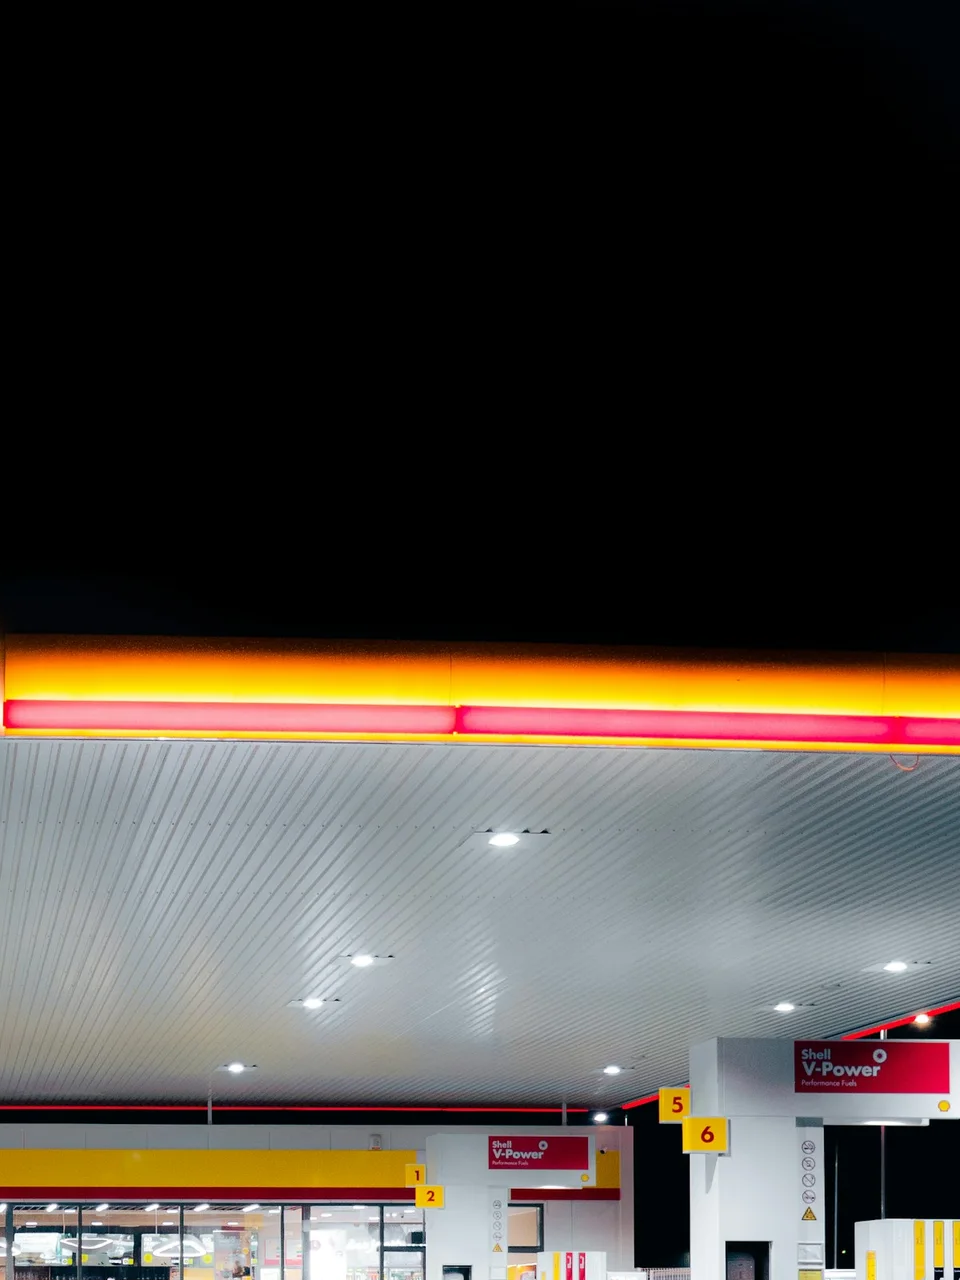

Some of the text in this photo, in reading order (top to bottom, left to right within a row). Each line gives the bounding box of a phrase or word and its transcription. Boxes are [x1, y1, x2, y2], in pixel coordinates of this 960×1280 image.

[801, 1049, 831, 1060] Shell
[802, 1061, 881, 1077] V-Power
[801, 1079, 857, 1087] Performance Fuels
[672, 1096, 683, 1113] 5
[700, 1126, 715, 1143] 6
[493, 1149, 544, 1159] V-Power
[415, 1170, 419, 1181] 1
[426, 1190, 435, 1202] 2
